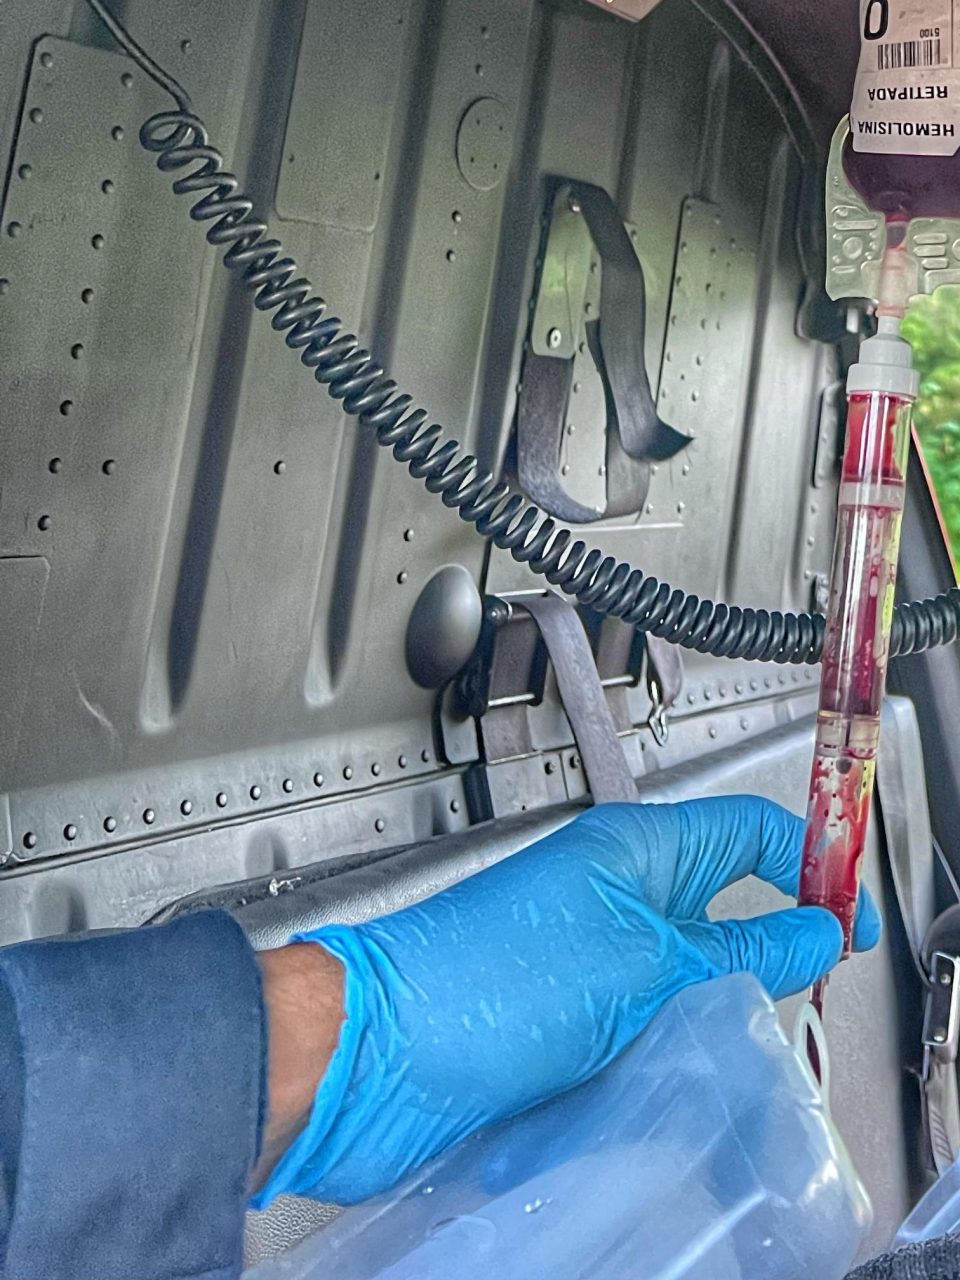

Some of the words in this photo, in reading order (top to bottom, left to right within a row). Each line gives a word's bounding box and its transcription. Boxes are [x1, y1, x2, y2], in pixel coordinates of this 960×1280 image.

[920, 27, 940, 38] 5100
[867, 86, 948, 101] RETIPADA
[858, 121, 954, 136] HEMOLISINA
